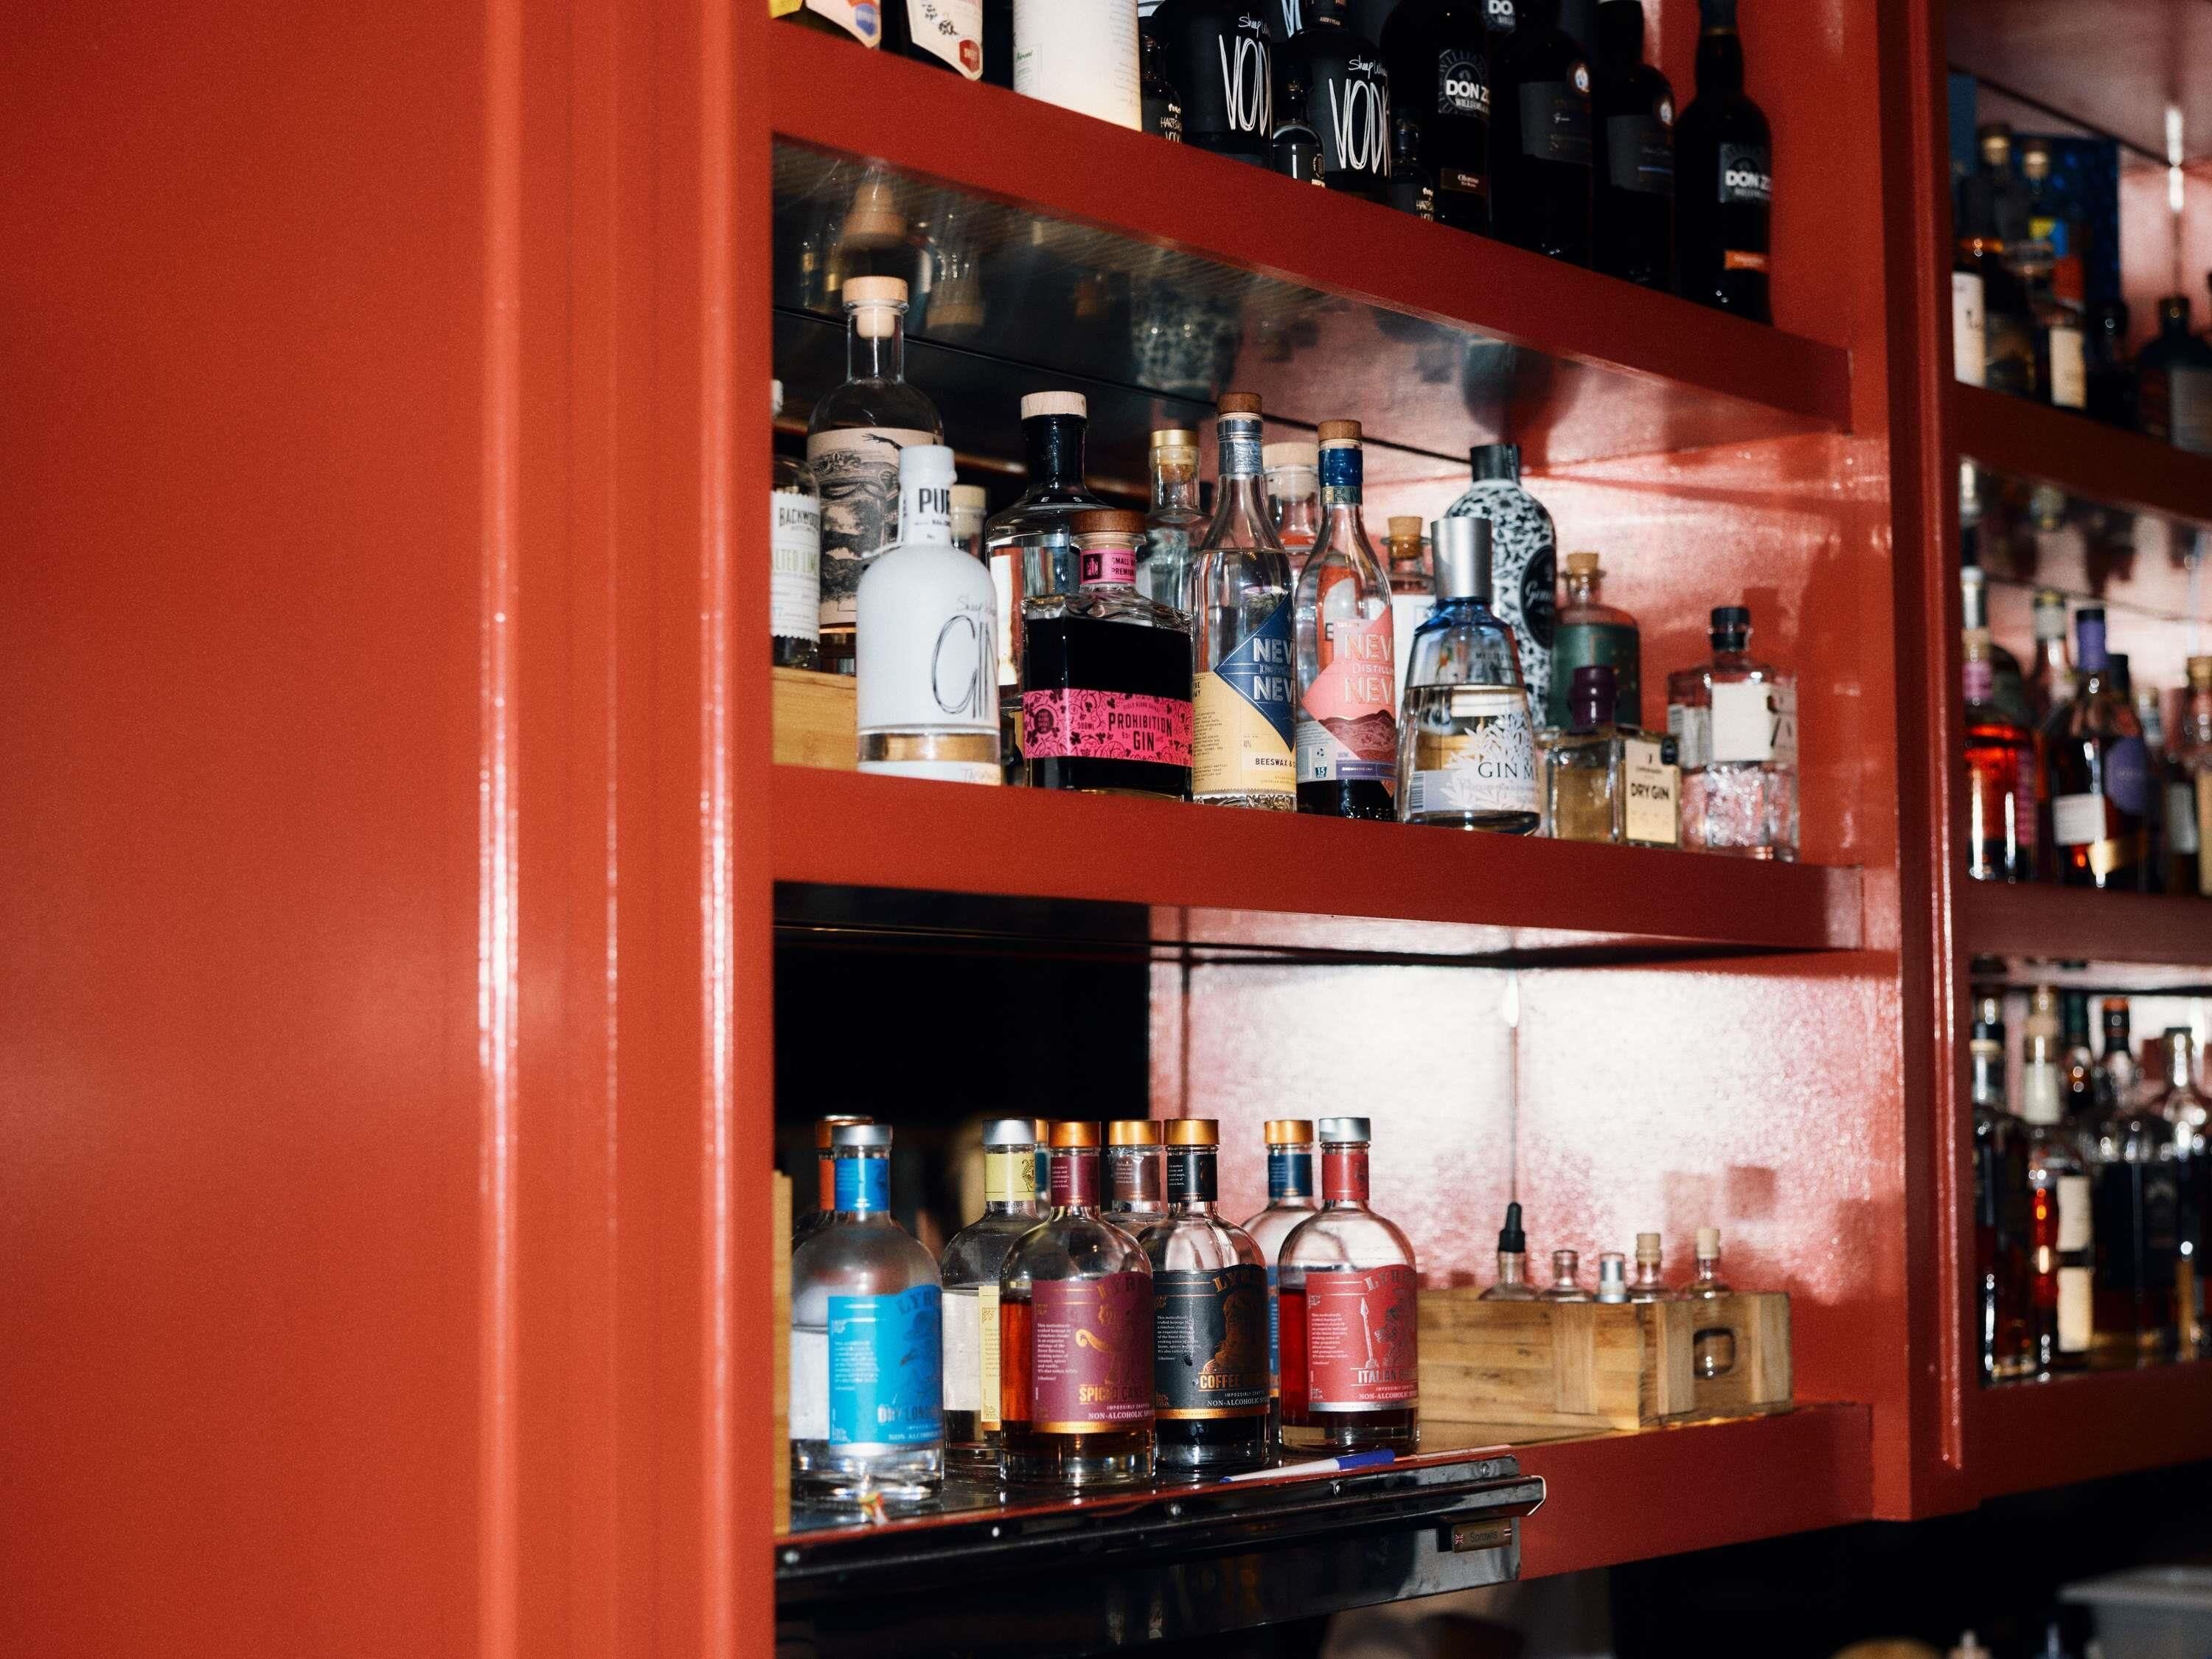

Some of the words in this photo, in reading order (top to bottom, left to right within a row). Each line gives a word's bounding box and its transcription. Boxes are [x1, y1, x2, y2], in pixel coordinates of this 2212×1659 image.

[1445, 79, 1480, 100] DON
[1108, 712, 1172, 736] PROHIBITION
[1133, 731, 1155, 751] GIN
[1478, 762, 1518, 779] GIN
[1630, 782, 1649, 797] DRY
[1651, 786, 1669, 799] GIN
